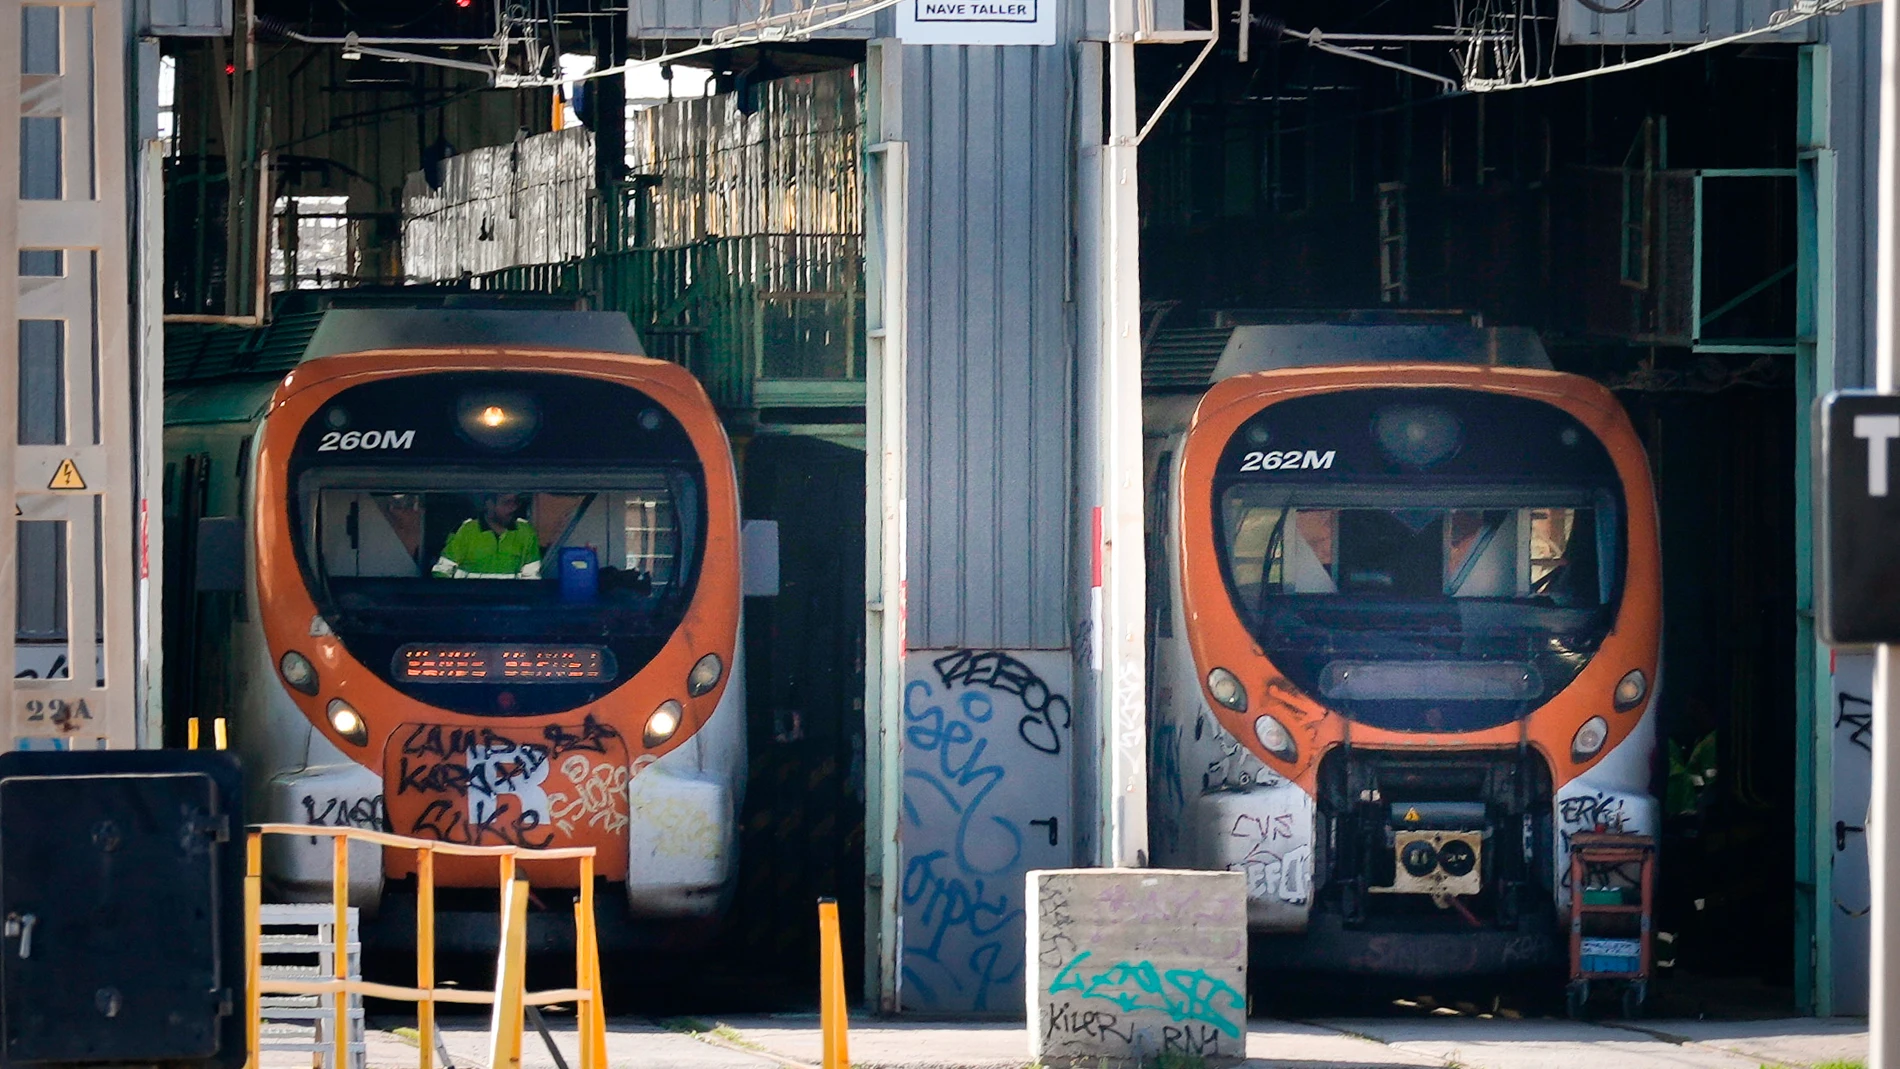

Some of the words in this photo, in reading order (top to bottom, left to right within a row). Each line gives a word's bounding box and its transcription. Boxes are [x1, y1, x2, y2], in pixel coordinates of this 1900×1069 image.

[926, 4, 966, 15] NAVE
[971, 4, 1027, 15] TALLER
[318, 430, 416, 452] 260M
[1240, 450, 1336, 472] 262M
